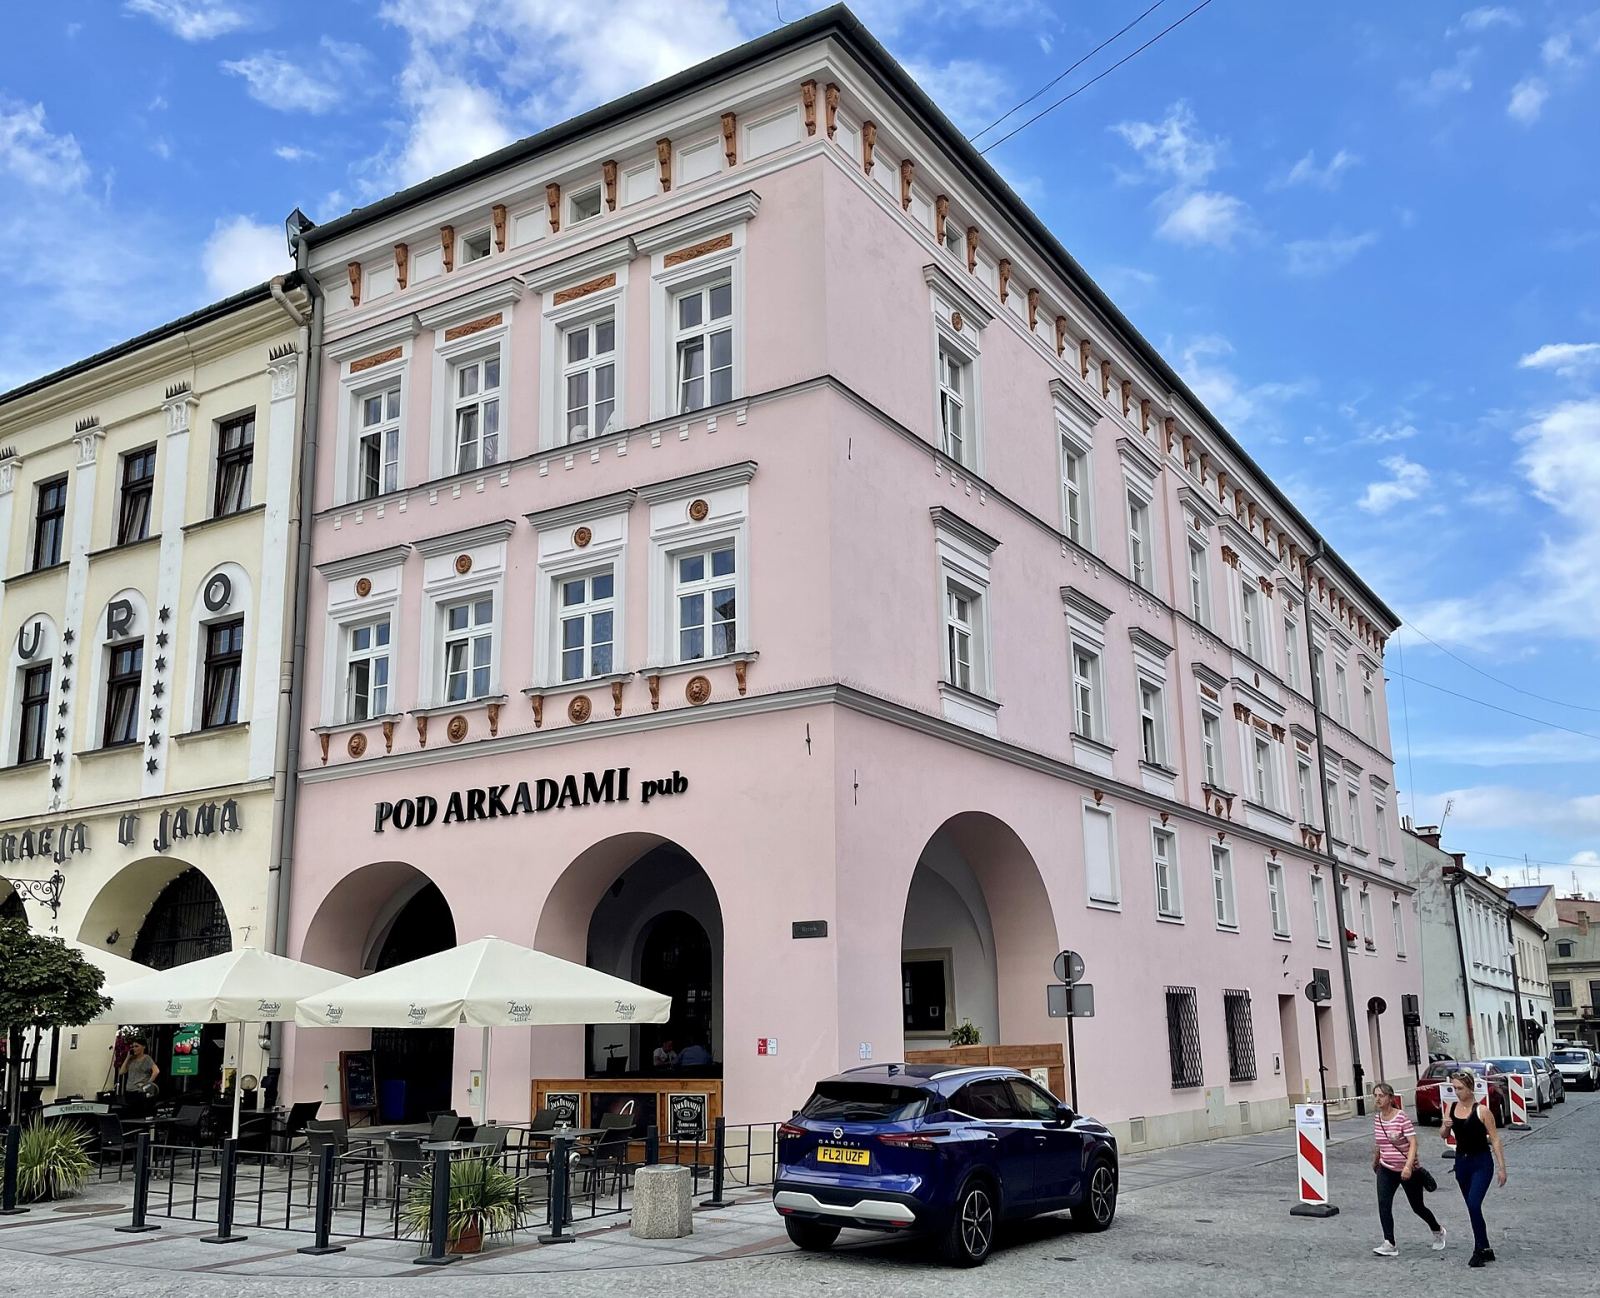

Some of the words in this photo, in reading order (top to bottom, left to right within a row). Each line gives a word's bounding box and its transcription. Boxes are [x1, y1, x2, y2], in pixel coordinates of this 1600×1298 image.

[153, 798, 240, 853] JANA
[374, 796, 438, 833] POD
[443, 767, 630, 824] ARKADAMI
[641, 770, 689, 803] pub
[822, 1148, 844, 1162] FL21
[845, 1149, 865, 1163] UZF
